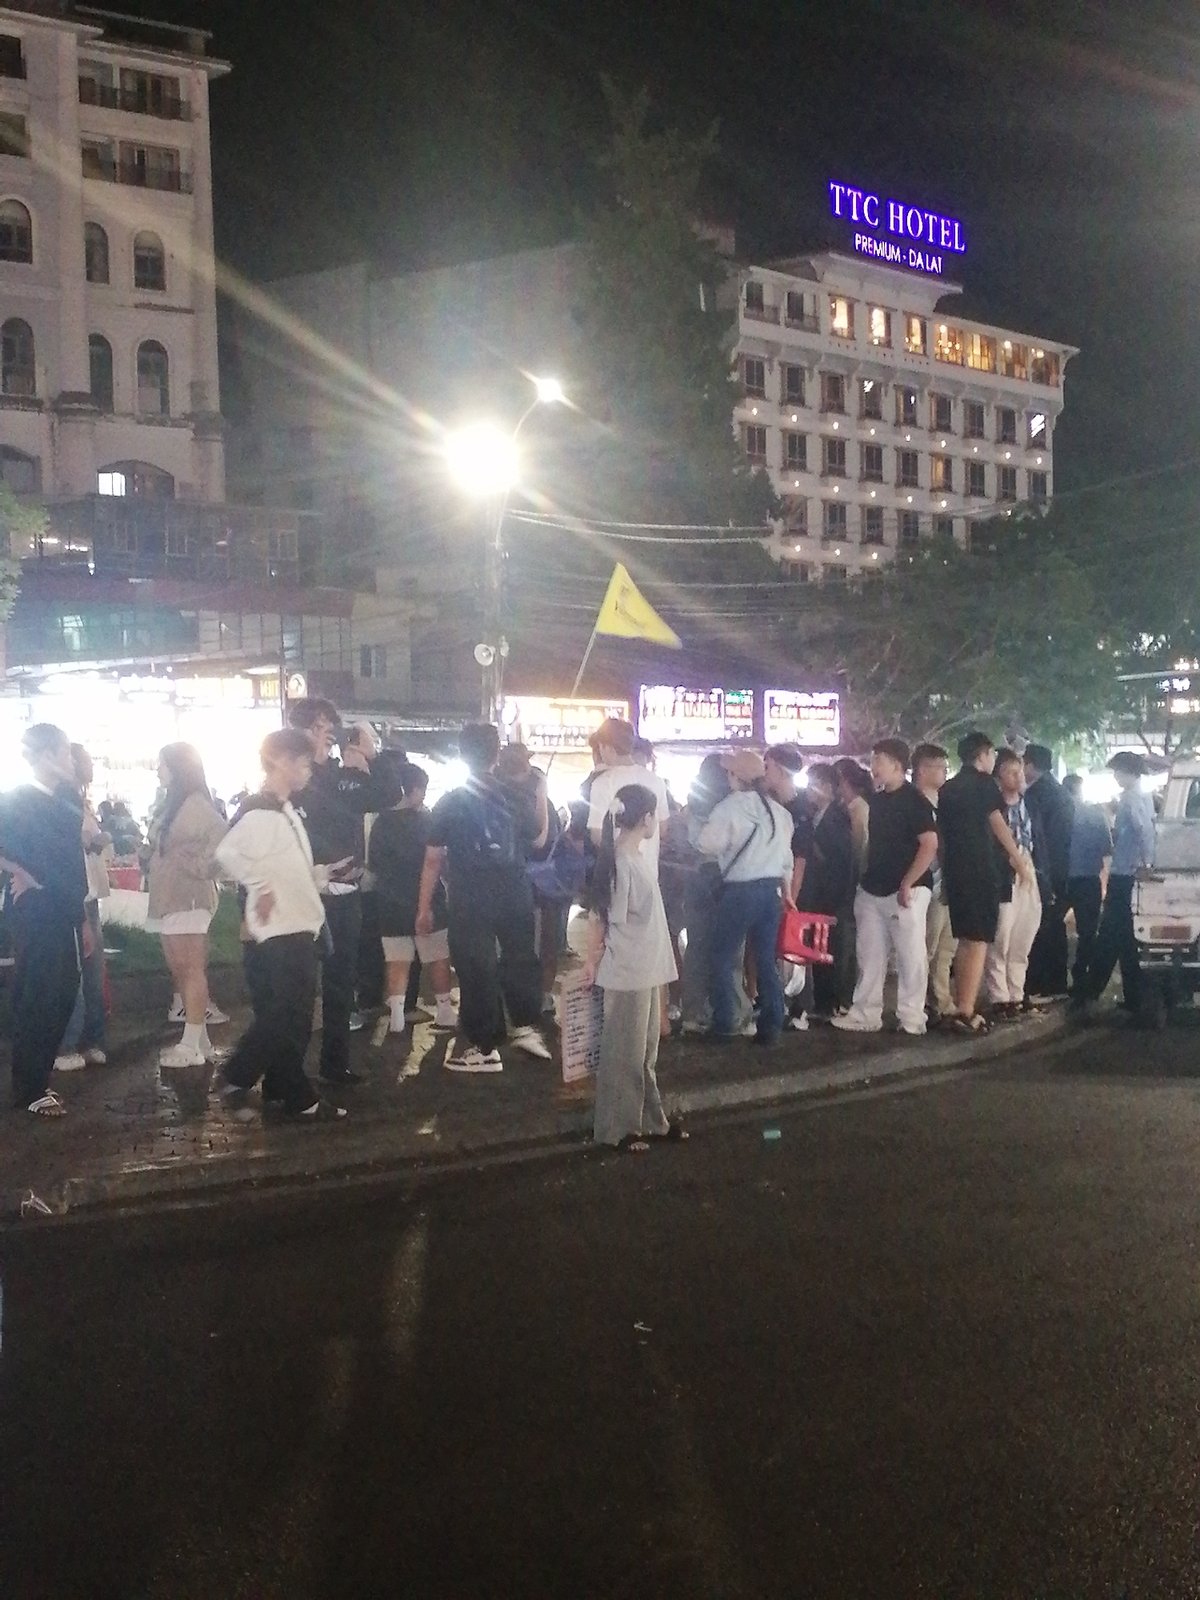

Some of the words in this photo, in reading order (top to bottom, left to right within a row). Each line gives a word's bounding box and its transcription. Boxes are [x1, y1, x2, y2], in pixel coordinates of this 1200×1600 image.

[830, 182, 879, 226] TTC
[888, 200, 965, 251] HOTEL
[855, 233, 901, 264] PREMIUM
